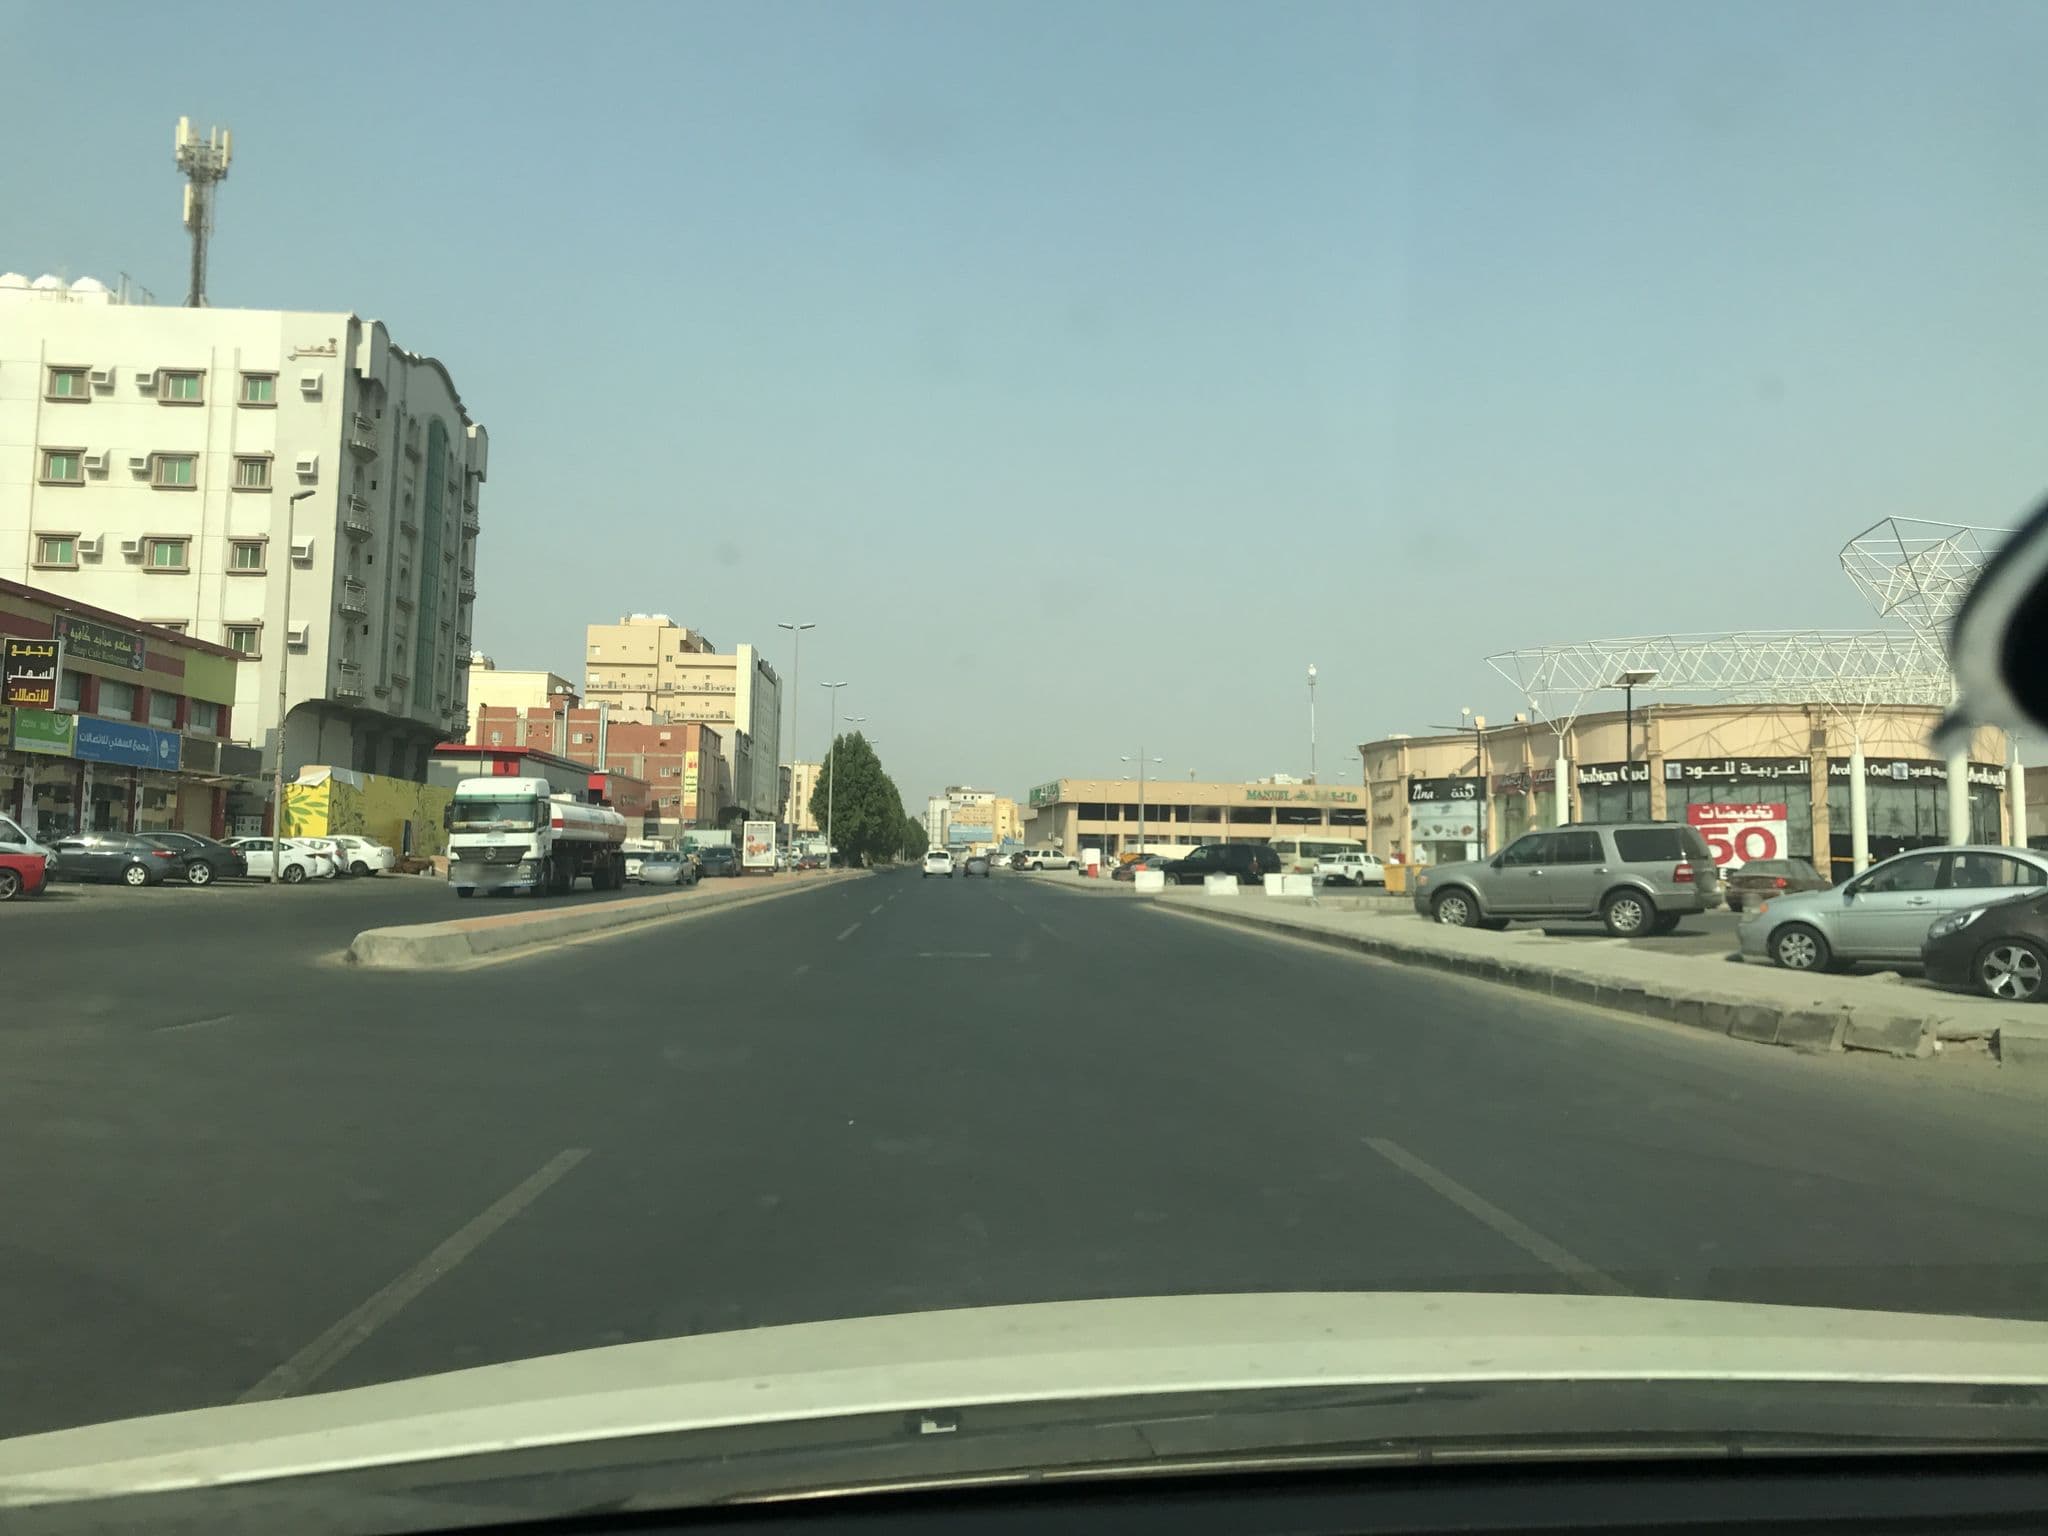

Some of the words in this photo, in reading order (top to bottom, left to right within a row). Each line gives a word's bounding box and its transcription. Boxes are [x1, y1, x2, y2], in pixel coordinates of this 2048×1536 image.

[11, 644, 54, 658] مجمع
[6, 665, 55, 684] السهلي
[1685, 760, 1737, 779] للعود
[1739, 760, 1809, 779] العربية
[1829, 763, 1870, 777] Arabn
[1870, 763, 1893, 777] Oud
[1246, 788, 1290, 801] MANUEL
[1698, 805, 1775, 823] تخفيضات
[1698, 826, 1777, 865] 50
